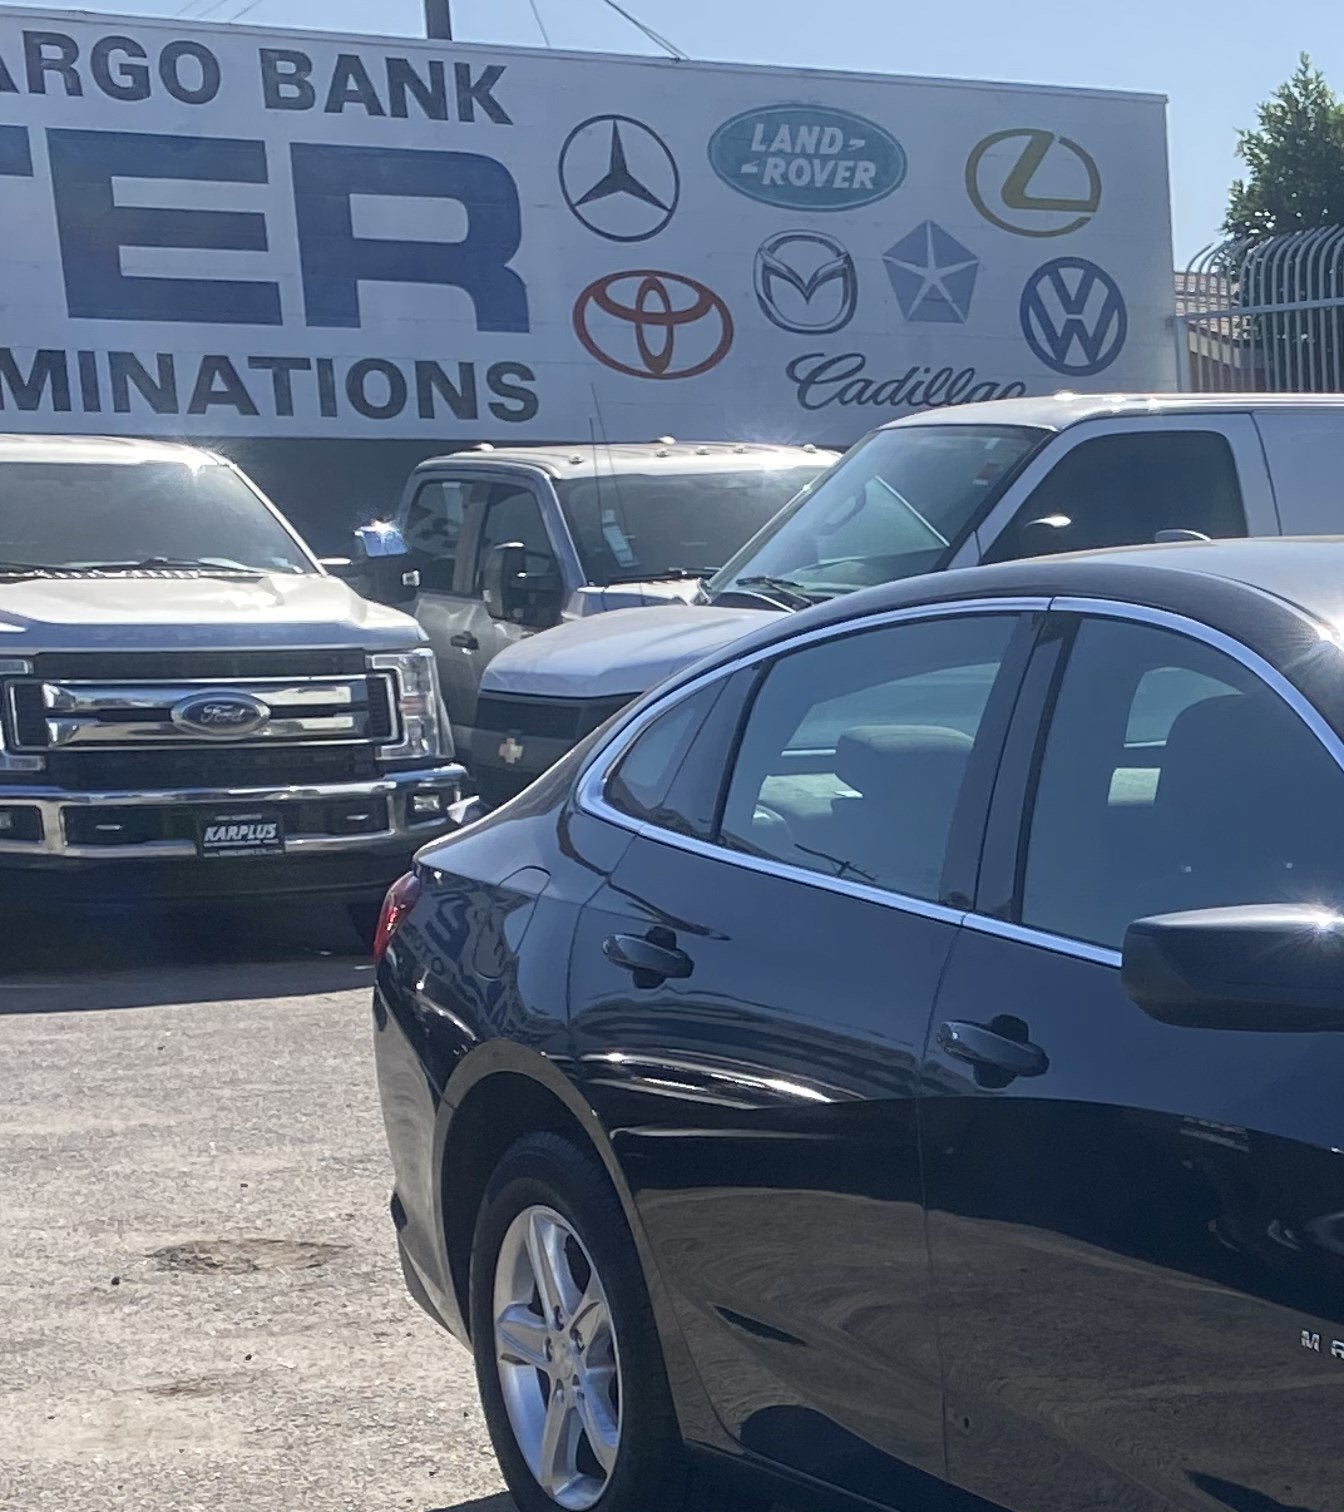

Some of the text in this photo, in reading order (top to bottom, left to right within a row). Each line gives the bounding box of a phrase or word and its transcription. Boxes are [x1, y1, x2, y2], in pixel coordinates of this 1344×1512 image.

[258, 47, 514, 126] BANK
[751, 122, 845, 155] LAND
[761, 156, 877, 190] ROVER
[0, 124, 531, 334] ER
[0, 347, 539, 423] MINATIONS
[200, 703, 246, 724] Ford
[203, 823, 278, 842] KARPLUS
